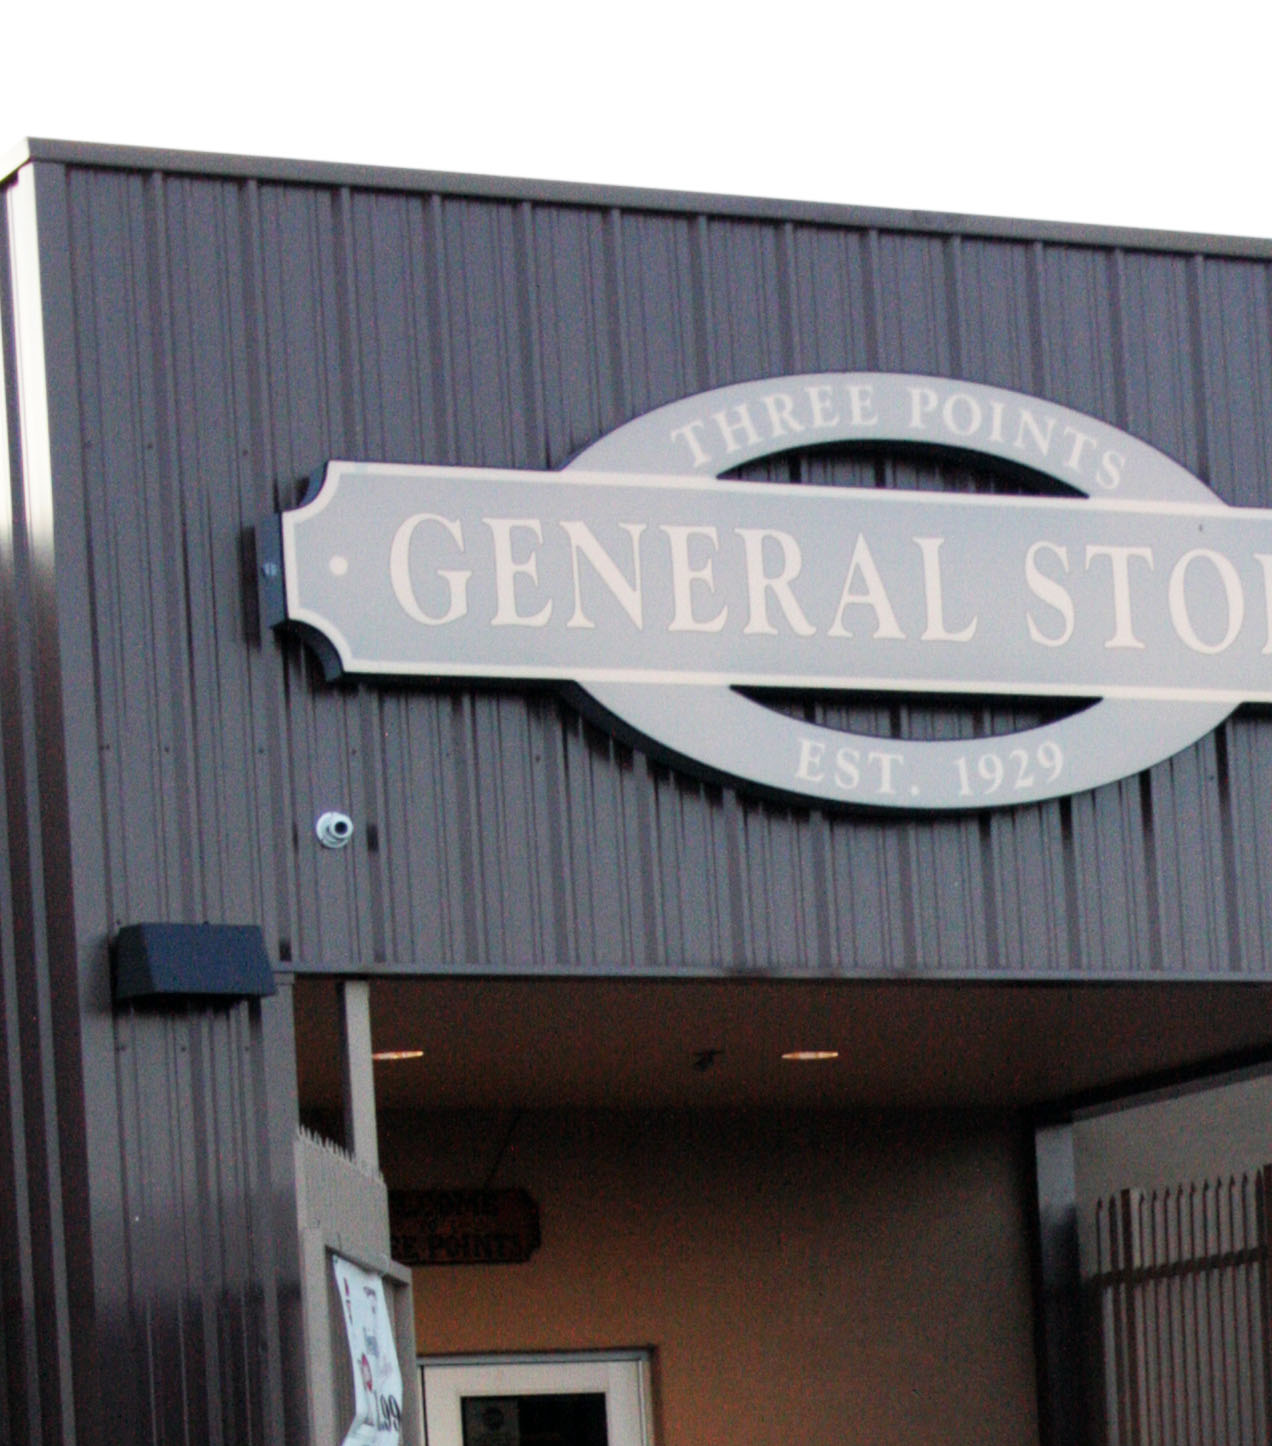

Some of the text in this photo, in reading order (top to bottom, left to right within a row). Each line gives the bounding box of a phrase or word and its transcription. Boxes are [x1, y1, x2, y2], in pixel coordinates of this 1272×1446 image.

[670, 384, 1126, 490] THREE POINTS
[389, 511, 978, 642] GENERAL
[794, 737, 1065, 797] EST. 1929
